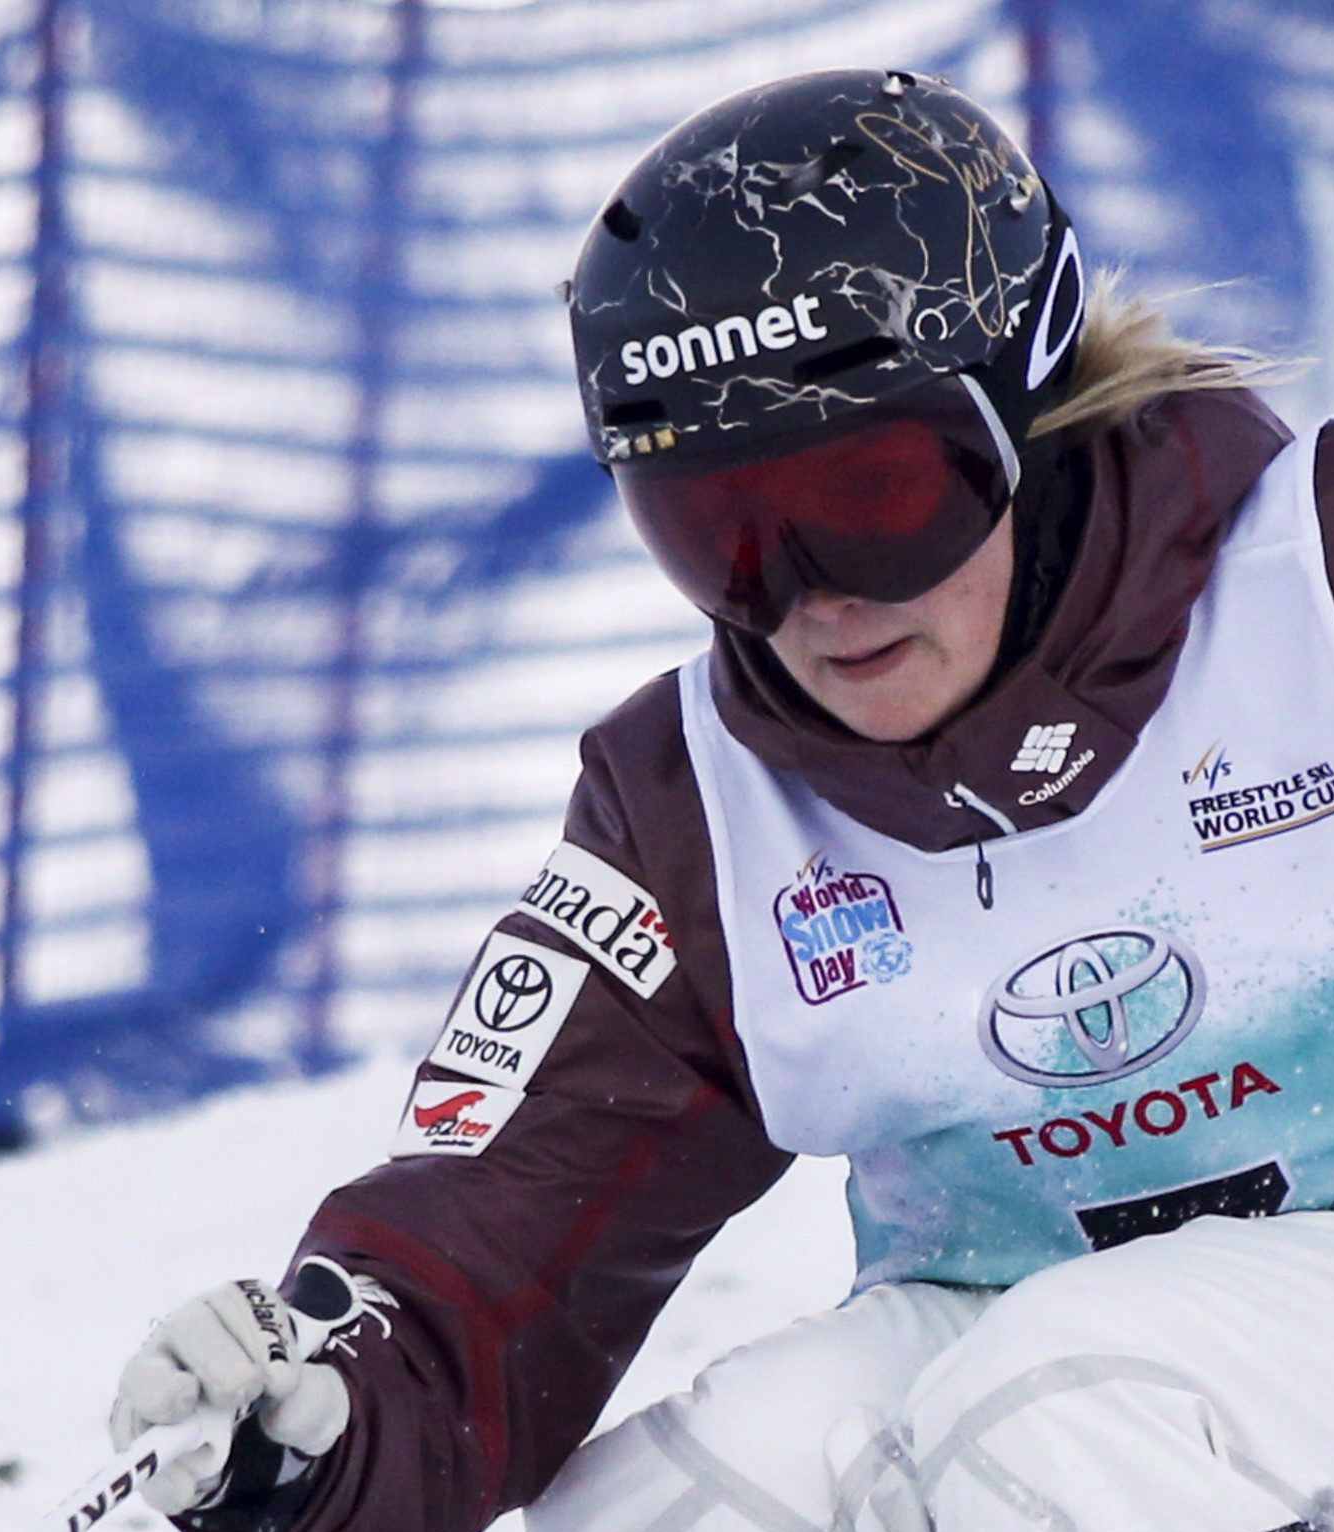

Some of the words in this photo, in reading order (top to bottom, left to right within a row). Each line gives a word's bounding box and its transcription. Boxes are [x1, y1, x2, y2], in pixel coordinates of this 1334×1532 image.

[621, 293, 827, 385] sonnet
[1018, 749, 1095, 806] Columbia
[1189, 774, 1306, 817] FREESTYLE
[1307, 762, 1334, 784] SKI
[1194, 800, 1295, 840] WORLD
[521, 868, 659, 983] anada
[810, 948, 855, 996] Day
[447, 1029, 522, 1073] TOYOTA
[993, 1062, 1282, 1165] TOYOTA
